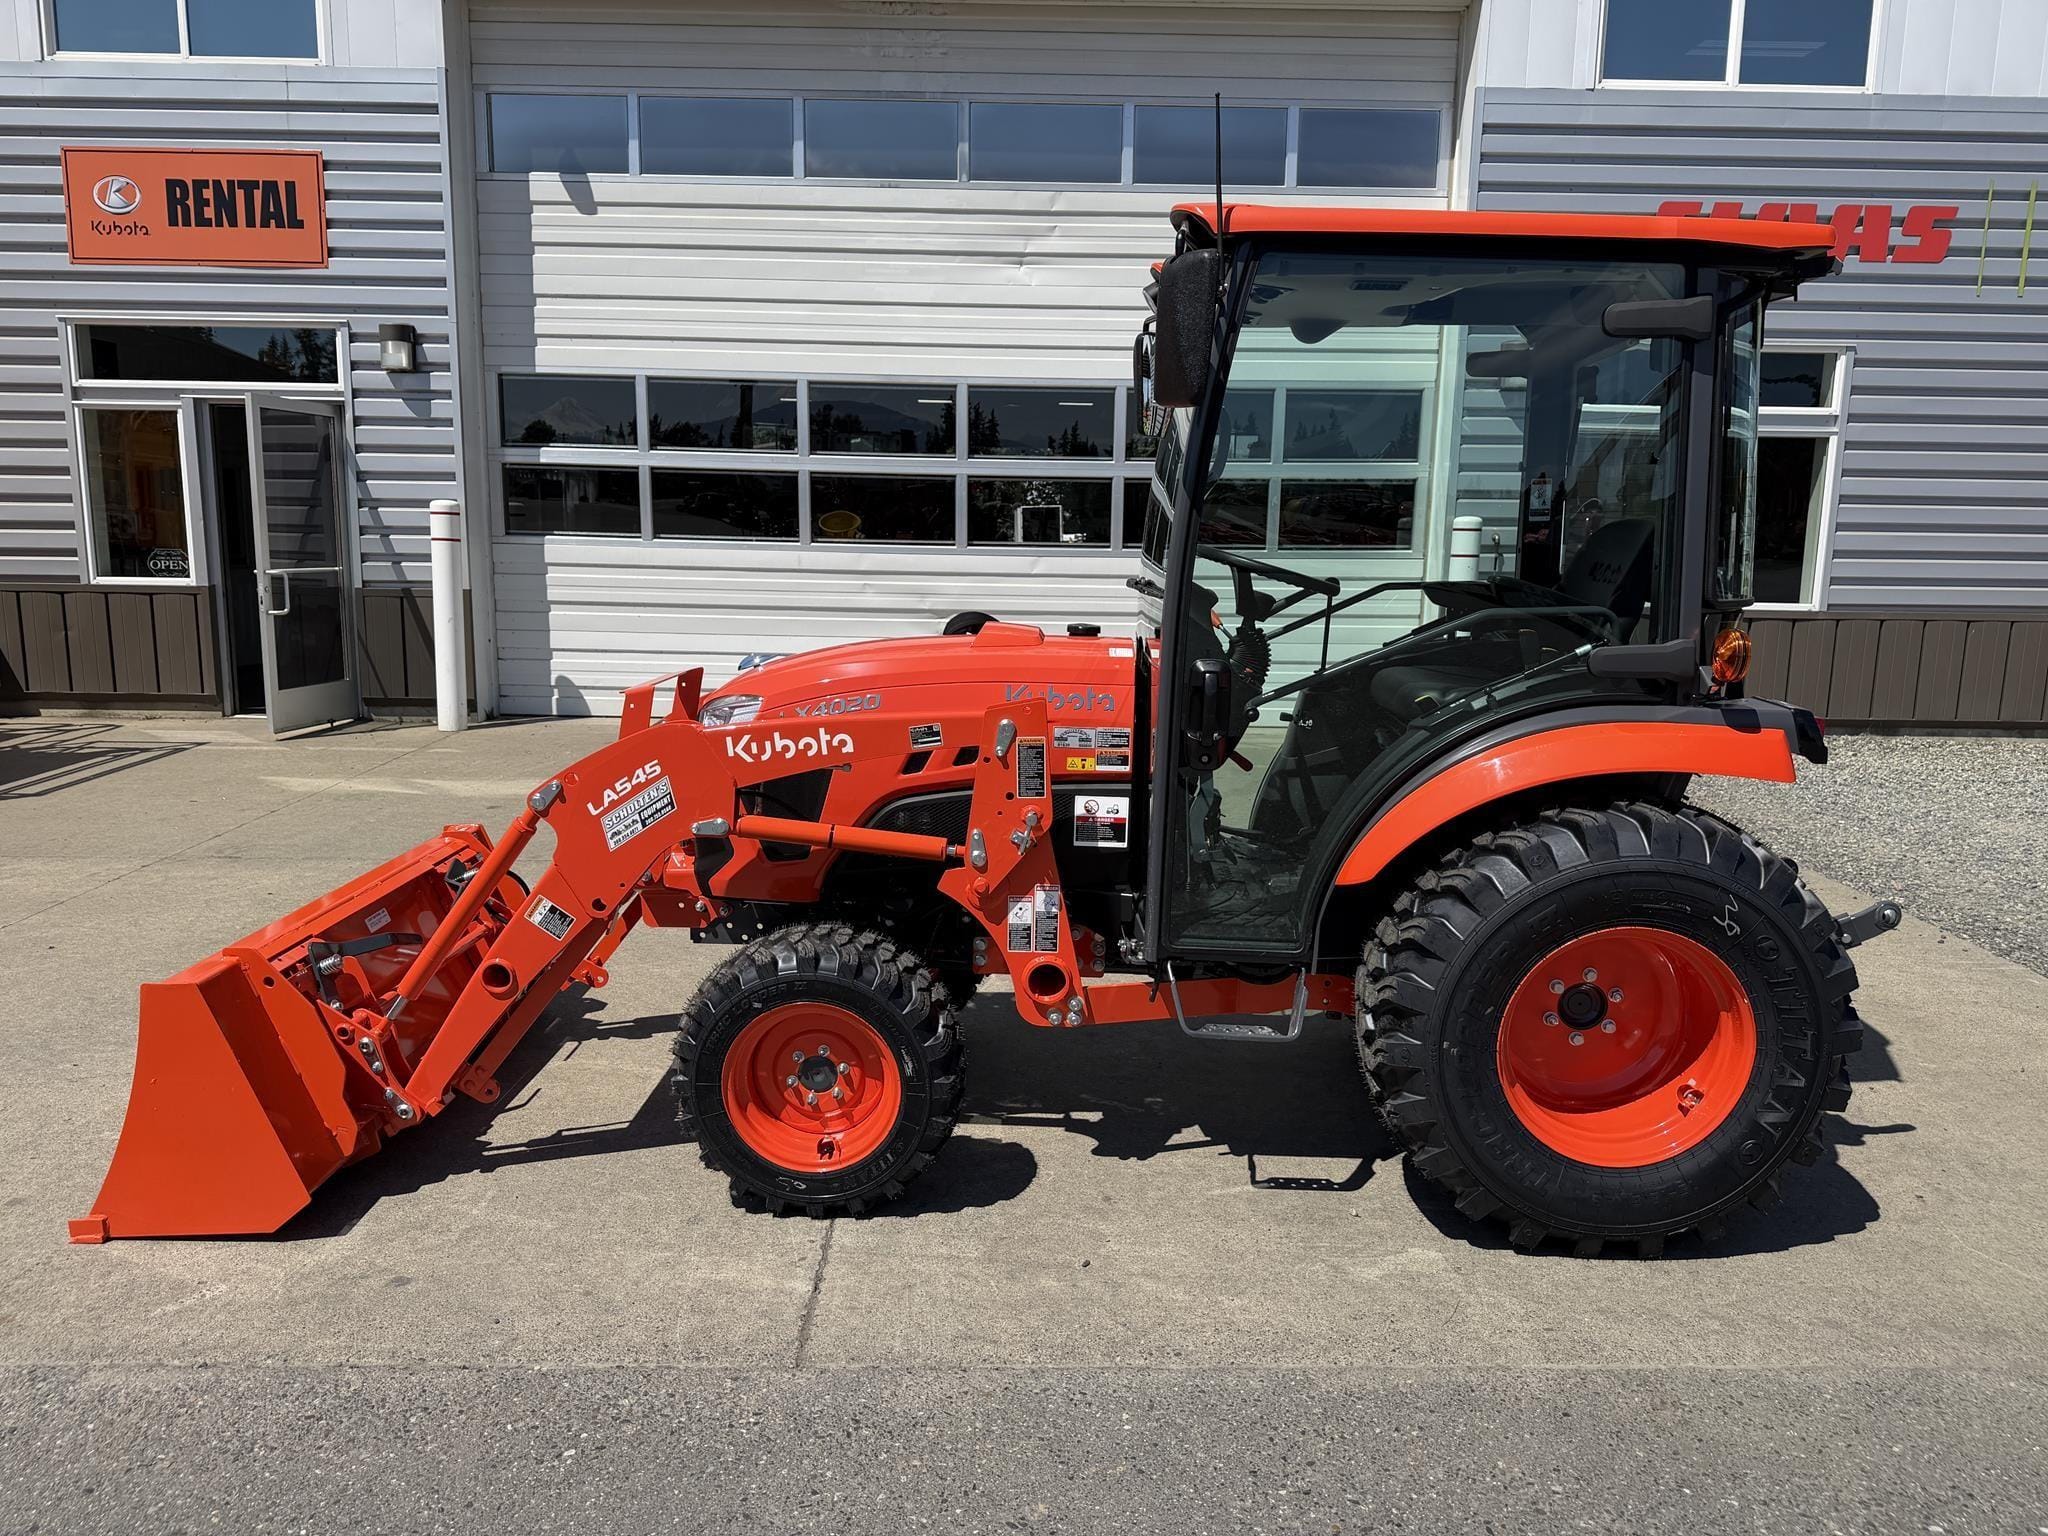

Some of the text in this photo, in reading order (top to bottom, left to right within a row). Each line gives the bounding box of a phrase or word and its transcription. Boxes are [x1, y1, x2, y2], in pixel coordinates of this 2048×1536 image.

[164, 177, 305, 230] RENTAL
[90, 219, 151, 237] Kubota
[149, 559, 189, 570] OPEN
[1005, 683, 1115, 712] Kbota
[725, 727, 855, 763] Kubota
[586, 759, 662, 817] LA545
[605, 782, 668, 829] SCHOLTEN'S
[640, 795, 672, 820] EQUIPMENT
[1756, 965, 1819, 1143] TITAN
